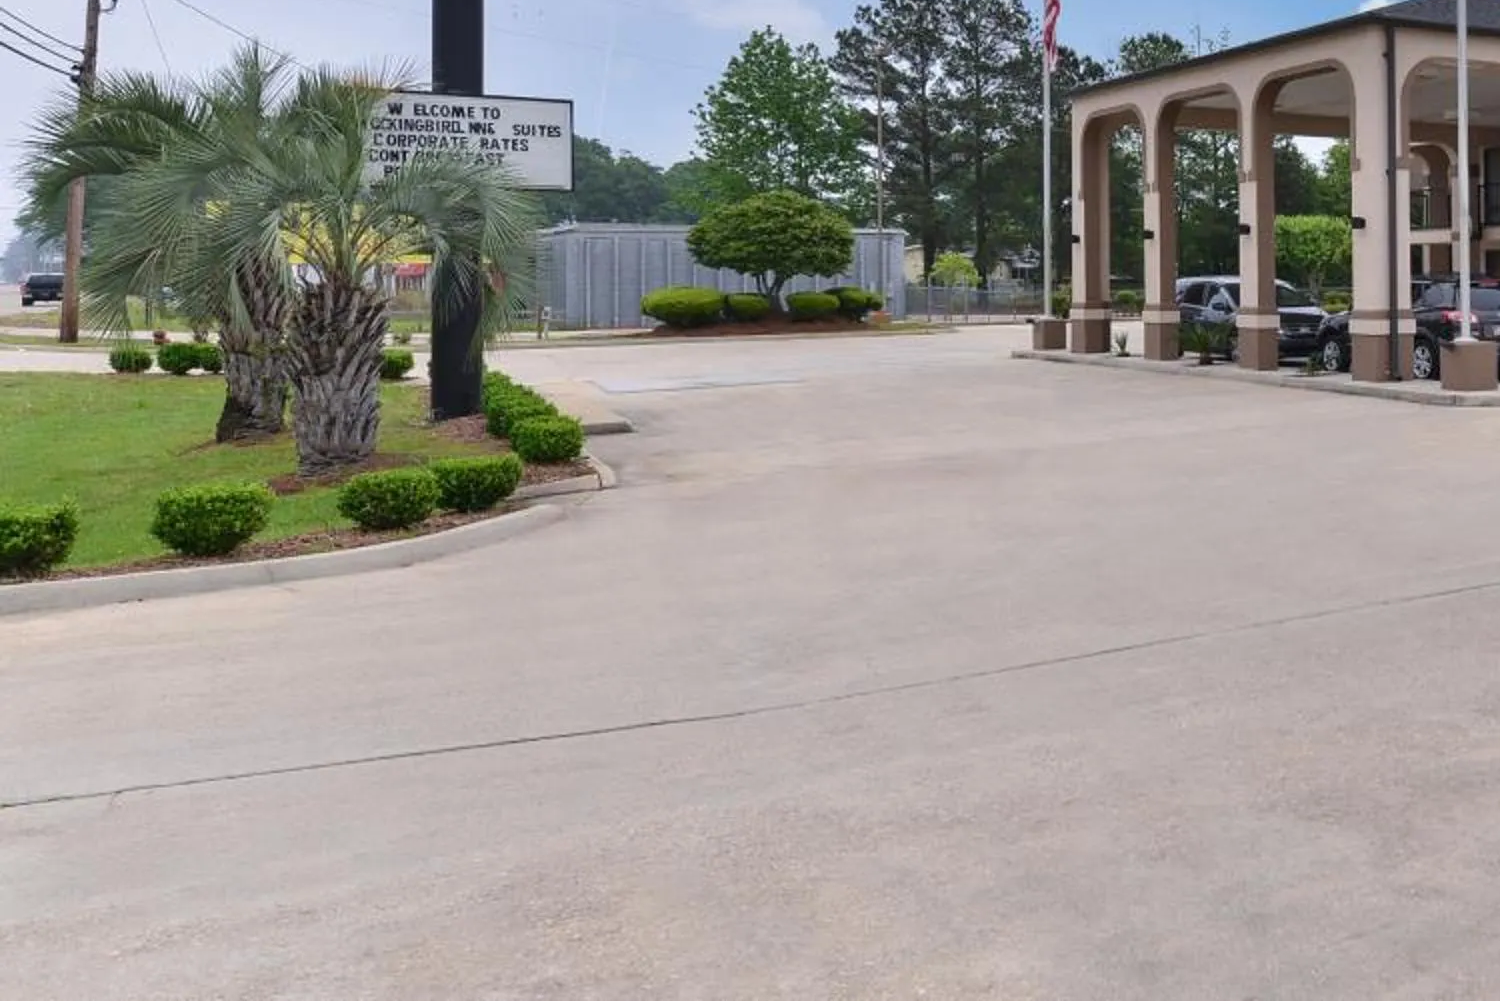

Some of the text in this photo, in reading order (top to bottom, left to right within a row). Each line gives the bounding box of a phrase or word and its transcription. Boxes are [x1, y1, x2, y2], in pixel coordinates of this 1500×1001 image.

[480, 106, 501, 120] TO
[512, 124, 561, 137] SUITES
[480, 138, 529, 152] RATES
